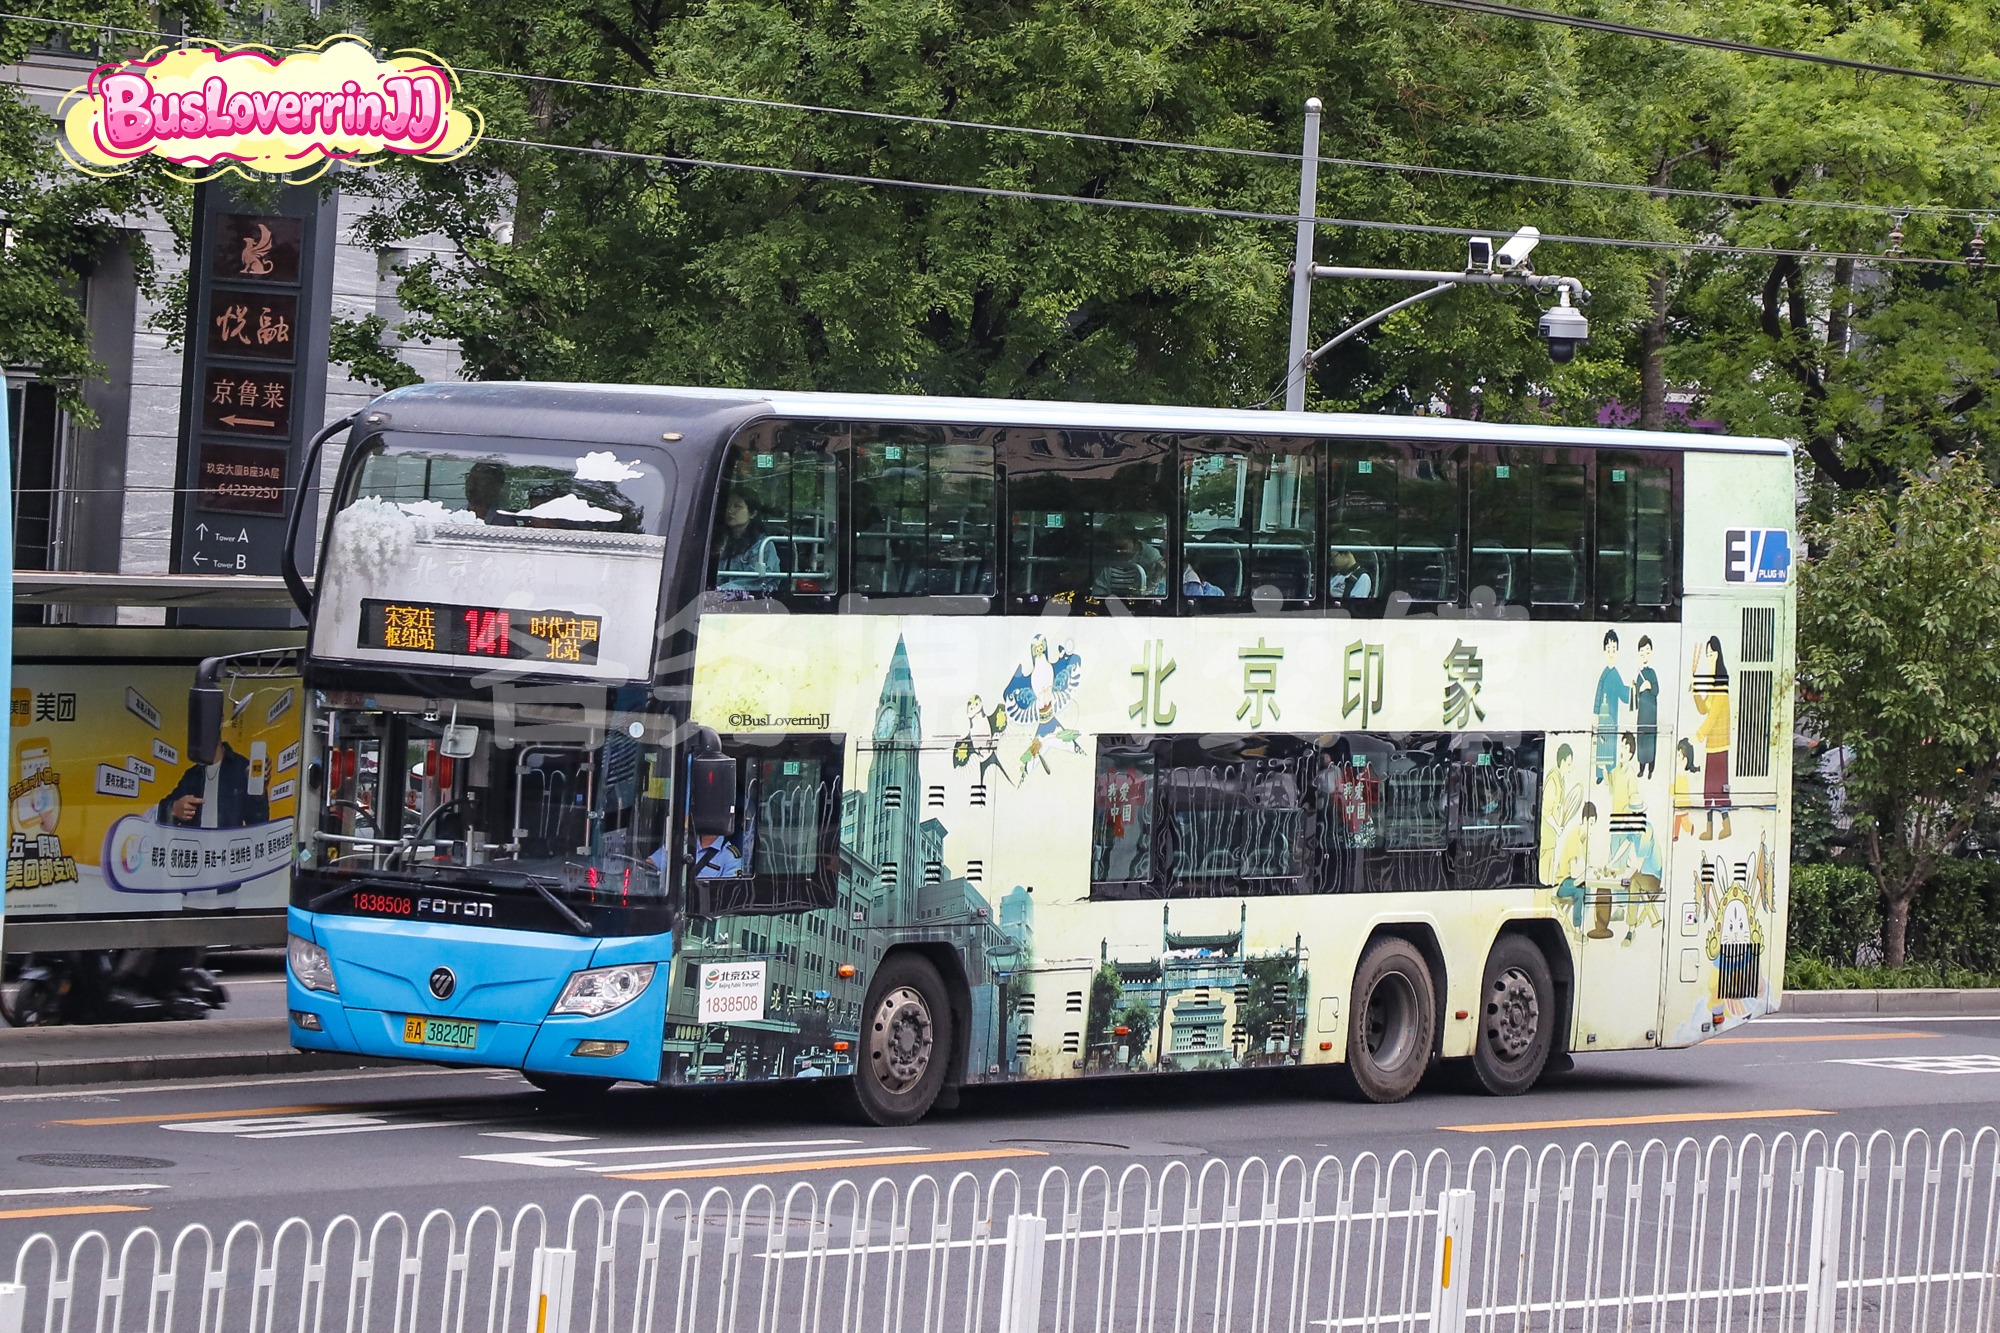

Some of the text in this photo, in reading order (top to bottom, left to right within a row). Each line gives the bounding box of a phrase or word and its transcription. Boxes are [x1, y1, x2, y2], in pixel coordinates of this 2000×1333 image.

[216, 304, 289, 345] 悦融
[211, 378, 285, 409] 京鲁菜
[206, 462, 280, 479] 玖安大厦B座3A层
[218, 483, 279, 499] 64229250
[215, 528, 249, 543] Tower A
[213, 554, 247, 569] Tower B
[1725, 530, 1767, 582] EV
[1758, 569, 1786, 578] PLUG-IN
[385, 606, 435, 629] 宋家庄
[530, 616, 598, 641] 时代庄园
[385, 626, 435, 650] 枢纽站
[464, 610, 511, 655] 141
[546, 638, 581, 661] 北站
[1128, 636, 1486, 728] 北京印象
[10, 699, 30, 715] 美团
[36, 692, 76, 723] 美团
[1110, 803, 1131, 823] 中国
[1345, 801, 1366, 820] 中国
[152, 846, 166, 868] 帮我
[170, 848, 199, 869] 领优惠券
[230, 845, 251, 865] 当地特色
[5, 857, 78, 890] 美团都安排
[352, 893, 493, 918] 1838508 FOTON
[718, 982, 731, 990] Beijing
[742, 981, 760, 989] Transport
[720, 970, 761, 981] 北京公交
[706, 995, 758, 1013] 1838508
[405, 1021, 476, 1045] 京A 38220F
